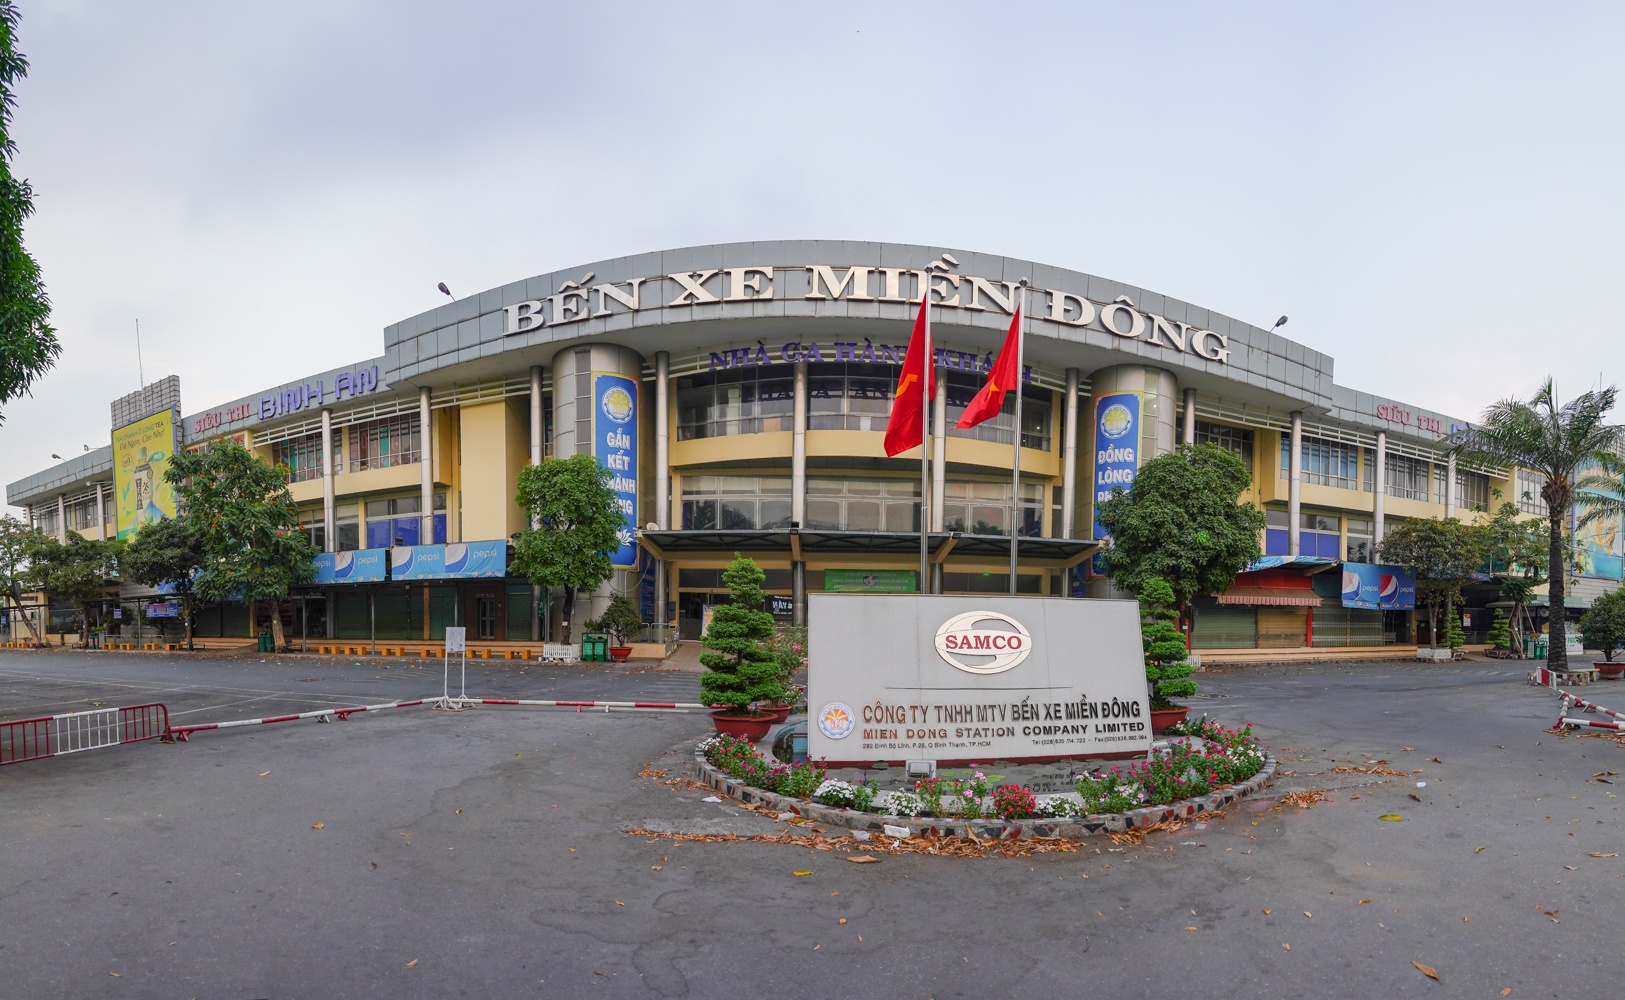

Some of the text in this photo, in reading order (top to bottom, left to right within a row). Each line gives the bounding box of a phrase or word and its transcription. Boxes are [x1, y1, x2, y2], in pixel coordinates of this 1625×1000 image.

[503, 254, 1231, 363] BẾN XE MIỀN ĐÔNG
[709, 340, 772, 371] NHÀ
[781, 342, 824, 363] GA
[834, 337, 912, 364] HÀN
[193, 411, 222, 433] SIÊU
[334, 364, 378, 399] AN
[1376, 403, 1412, 426] SIÊU
[1417, 414, 1443, 437] THỊ
[606, 427, 631, 450] GẮN
[607, 450, 630, 471] KẾT
[1097, 443, 1135, 465] ĐỒNG
[1097, 467, 1134, 486] LÒNG
[357, 555, 378, 565] pepsi
[417, 551, 440, 563] pepsi
[473, 548, 497, 559] pepsi
[945, 634, 1023, 651] SAMCO
[863, 701, 906, 724] CÔNG
[910, 705, 929, 723] TY
[934, 704, 973, 723] TNHH
[976, 704, 1007, 723] MTV
[1011, 695, 1040, 721] BẾN
[1043, 703, 1063, 721] XE
[1065, 694, 1099, 719] MIỀN
[1101, 697, 1141, 718] ĐÔNG
[862, 722, 1145, 740] MIEN DONG STATION COMPANY LIMITED
